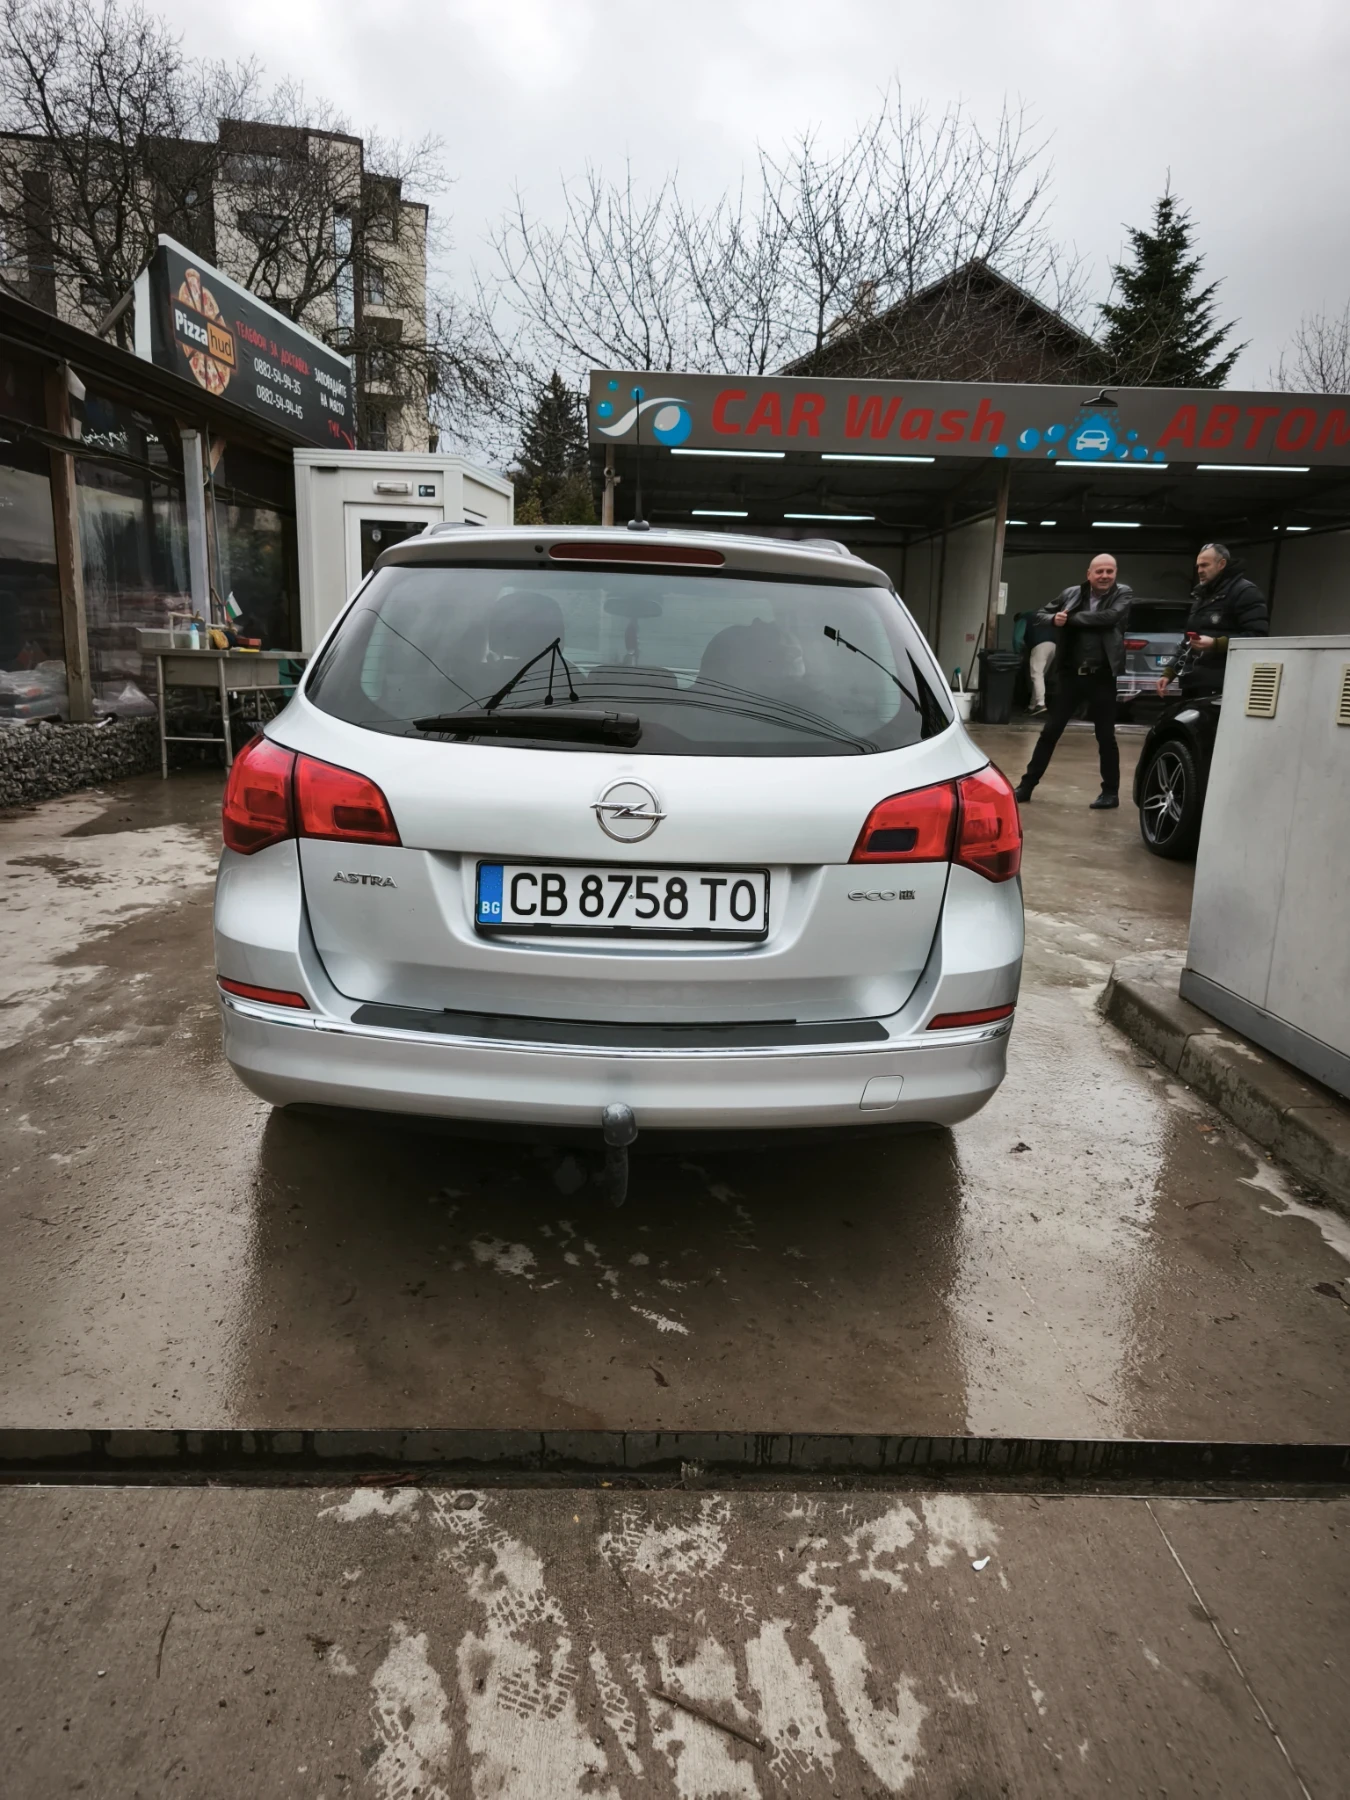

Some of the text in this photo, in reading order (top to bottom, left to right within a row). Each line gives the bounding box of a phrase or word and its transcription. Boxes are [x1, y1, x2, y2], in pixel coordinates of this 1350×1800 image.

[175, 308, 232, 358] Pizza hud
[253, 357, 302, 396] 0882-54-94-35
[256, 384, 304, 420] 0882-54-94-45
[320, 392, 328, 408] НА
[711, 388, 1006, 443] CAR Wash
[333, 870, 398, 889] ASTRA
[578, 874, 689, 920] 8758
[481, 901, 500, 914] BG
